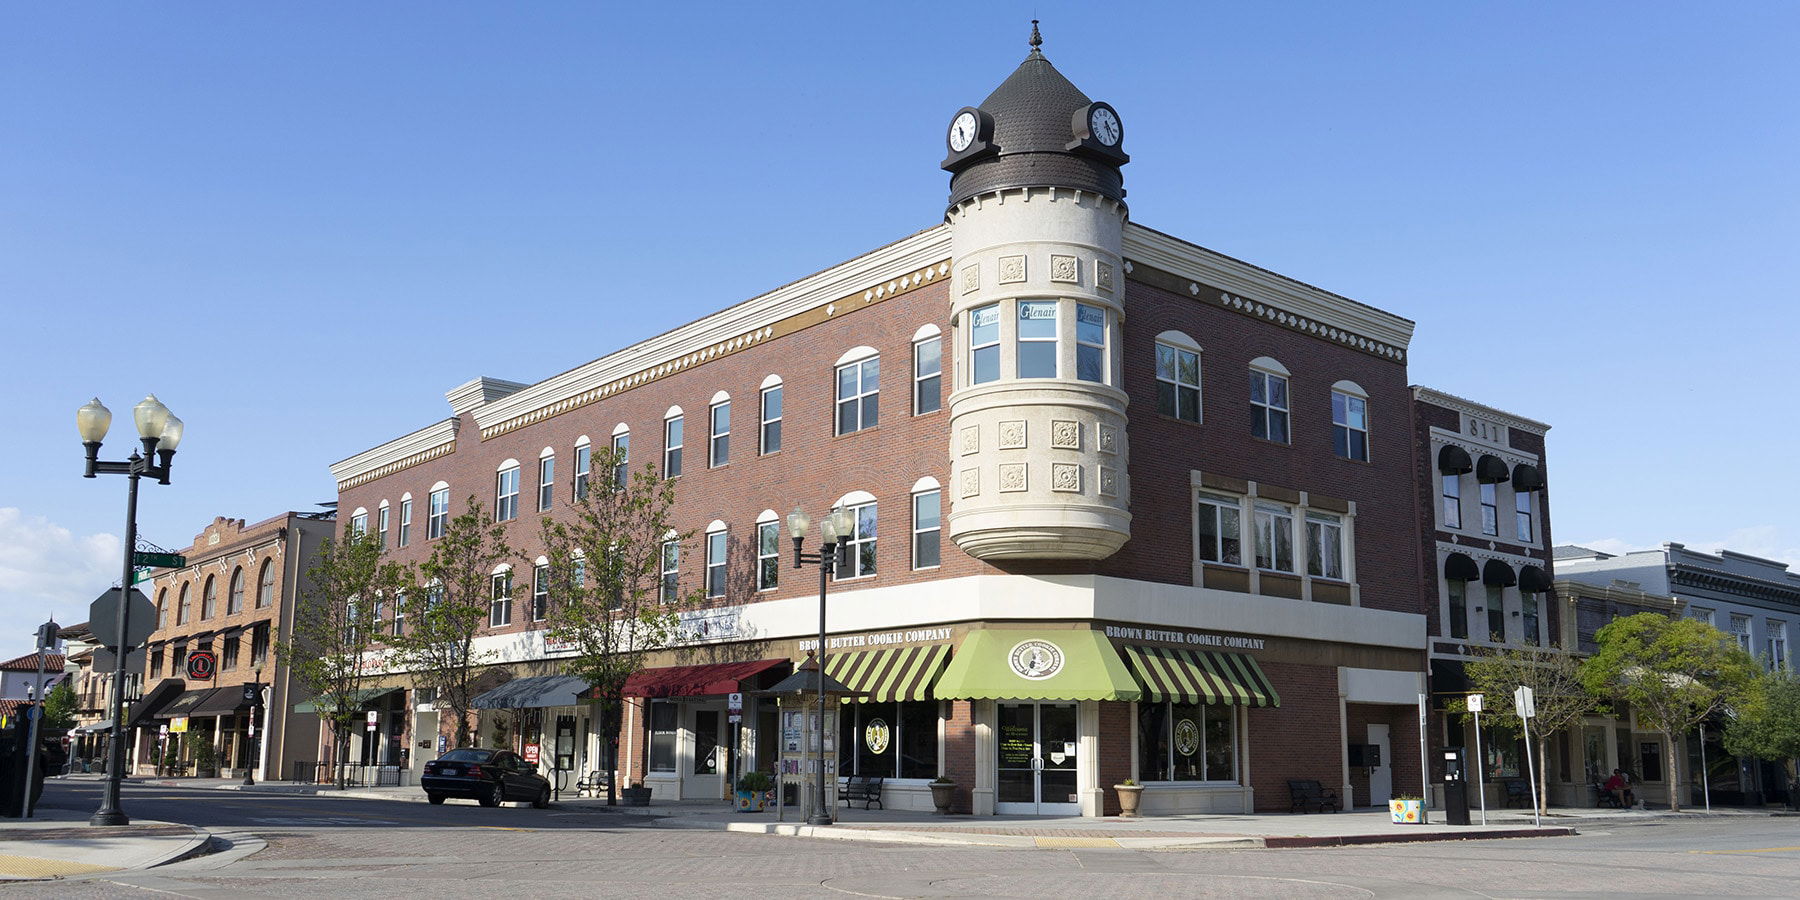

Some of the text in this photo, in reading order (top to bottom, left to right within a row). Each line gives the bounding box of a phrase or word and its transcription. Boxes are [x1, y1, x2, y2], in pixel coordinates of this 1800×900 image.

[974, 312, 999, 327] Glenair
[1020, 303, 1056, 318] Glenair
[1470, 419, 1498, 442] 811
[172, 556, 185, 566] ST
[831, 635, 865, 649] BUTTER
[867, 632, 903, 646] COOKIE
[906, 628, 952, 643] COMPANY
[1106, 625, 1265, 650] BROWN BUTTER COOKIE COMPANY
